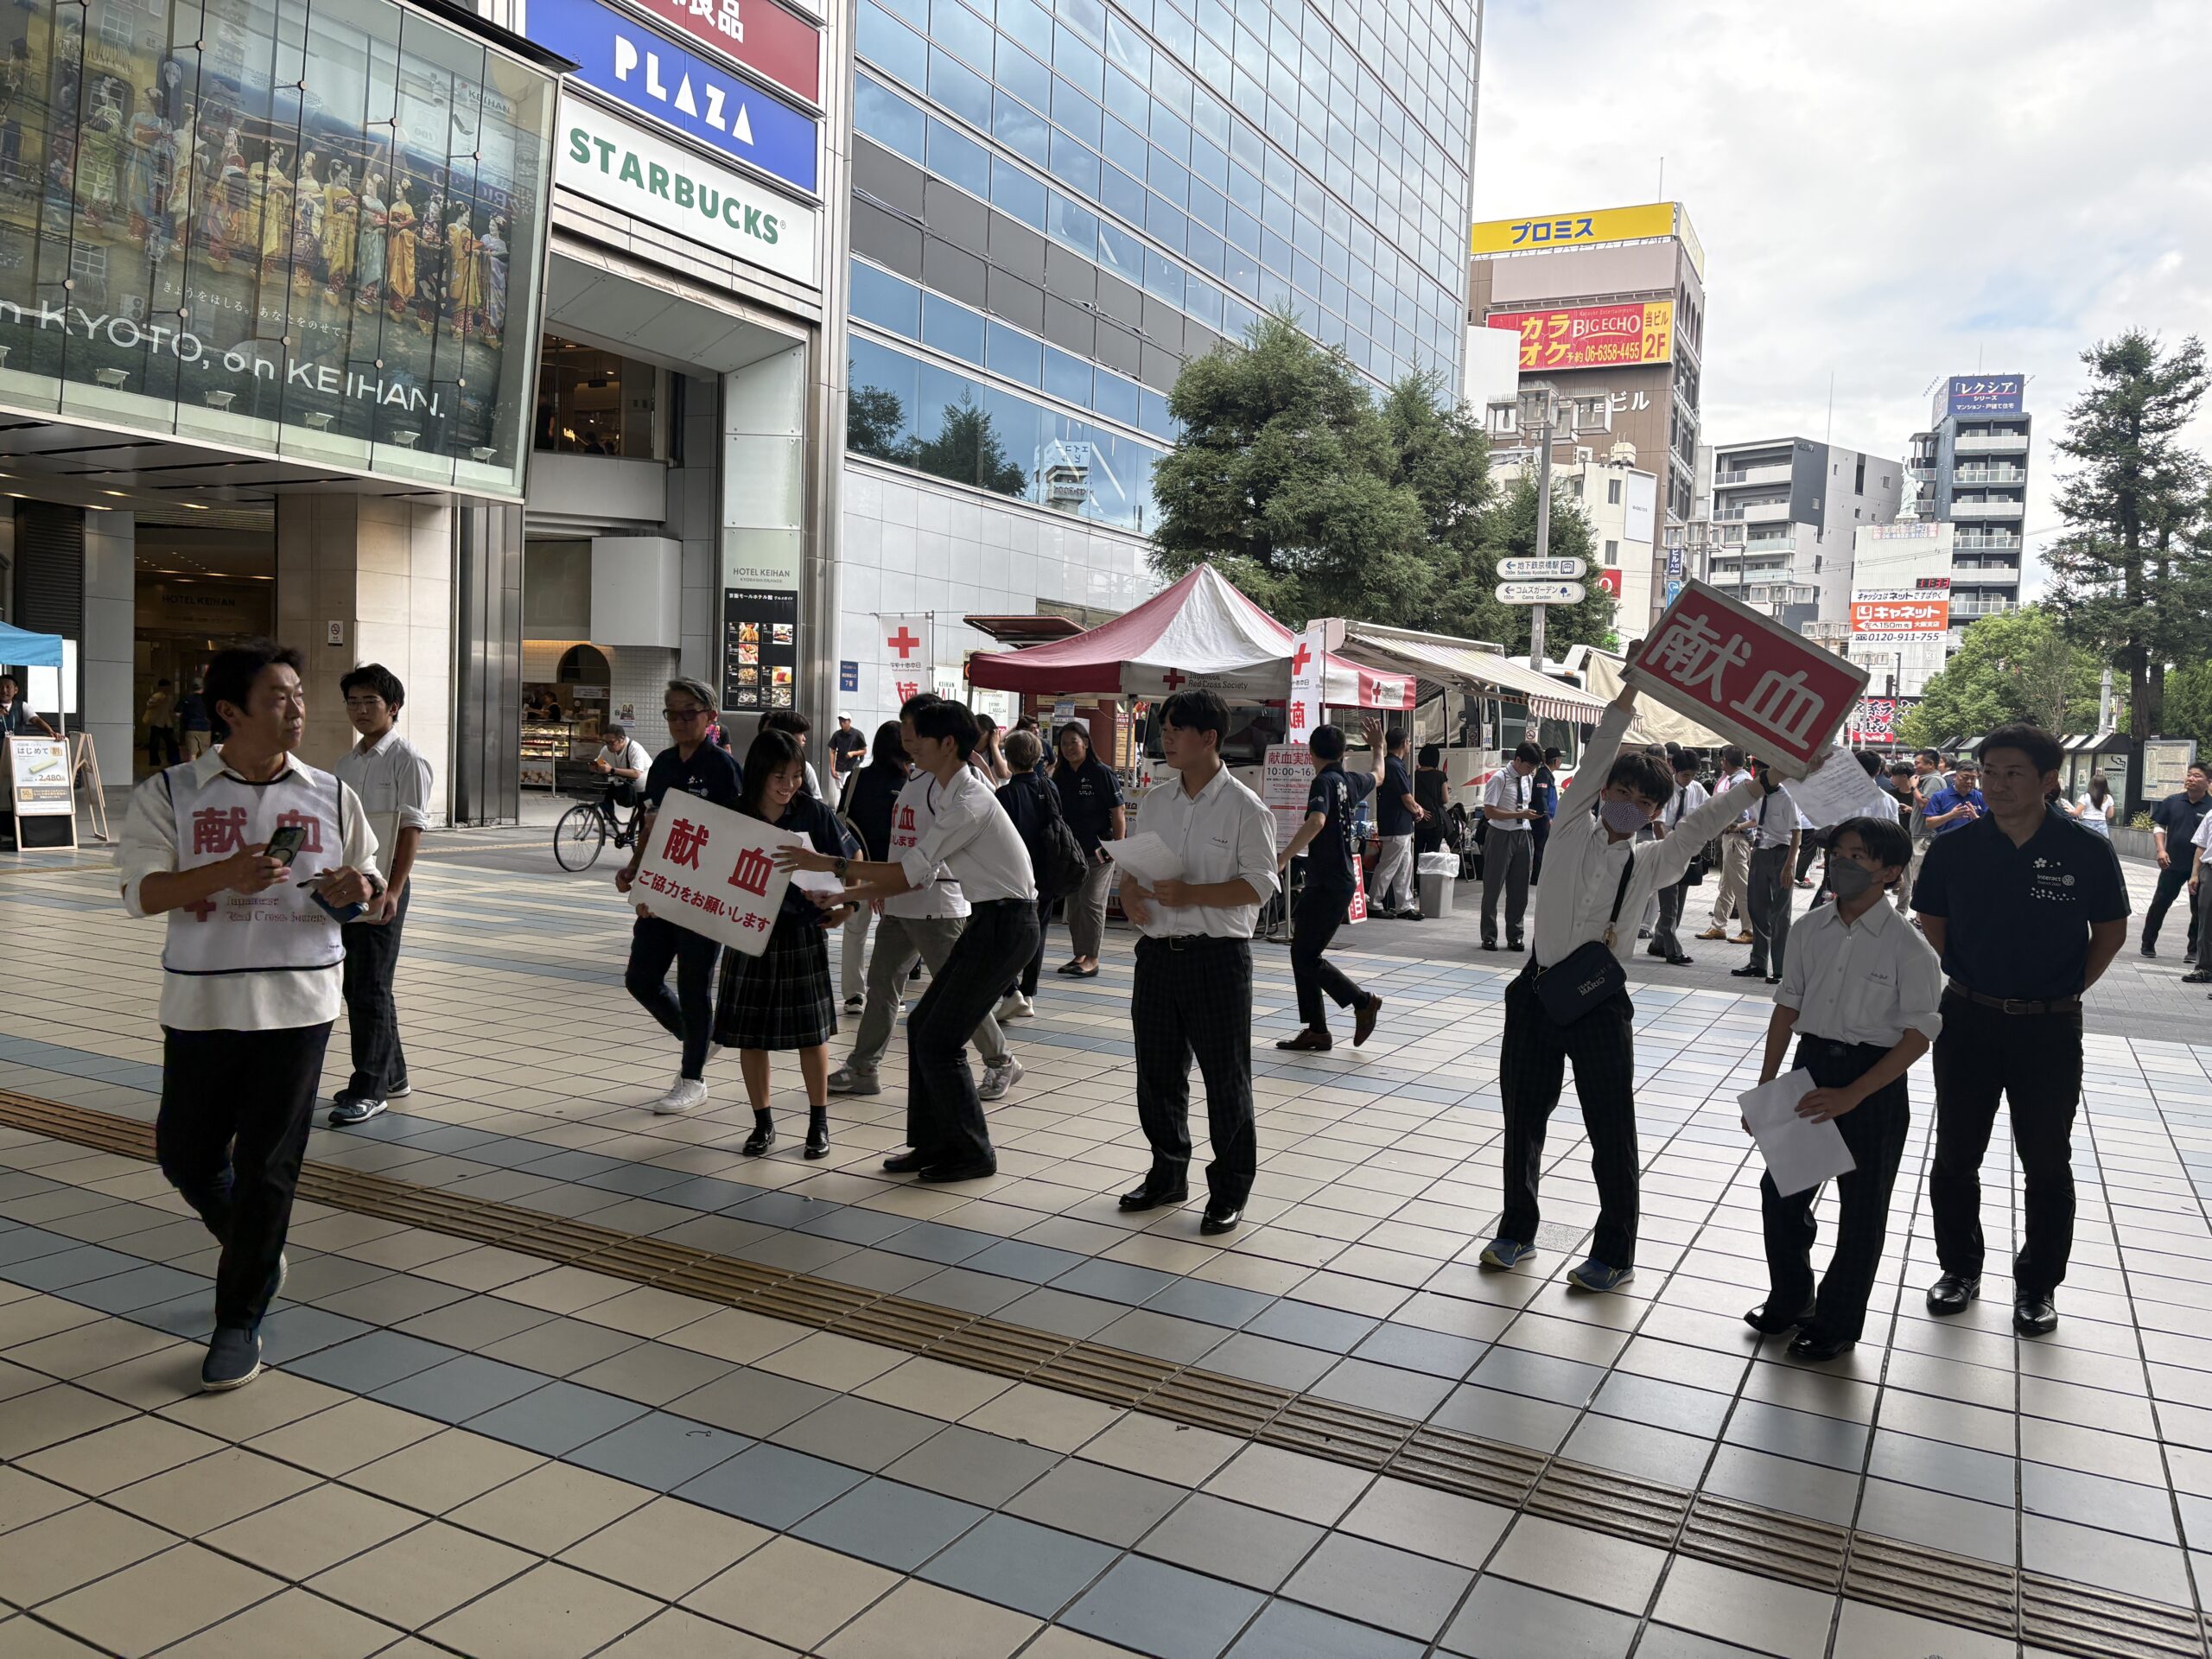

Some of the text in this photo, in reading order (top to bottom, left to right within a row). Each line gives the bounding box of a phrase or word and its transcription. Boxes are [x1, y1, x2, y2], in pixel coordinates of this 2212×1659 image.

[672, 0, 744, 43] 良品
[615, 34, 754, 146] PLAZA
[569, 128, 779, 245] STARBUCKS
[1511, 218, 1594, 245] プロミス
[1521, 314, 1571, 340] カラ
[1573, 315, 1641, 338] BIG ECHO
[1644, 310, 1669, 328] 当ビル
[41, 300, 209, 370] KYOTO,
[223, 352, 275, 379] on
[288, 358, 445, 418] KEIHAN.
[1566, 342, 1640, 364] 予約 06-6358-4455
[1643, 334, 1666, 359] 2F
[760, 569, 790, 577] KEIHAN
[1517, 561, 1559, 569] 地下鉄京橋駅
[1874, 606, 1941, 619] キャネット
[1203, 680, 1221, 689] Cross
[1223, 681, 1248, 690] Society
[1645, 613, 1824, 750] 献血
[892, 803, 916, 831] 血
[663, 817, 776, 897] 献血
[2037, 874, 2061, 882] Interact
[226, 896, 280, 907] Japanese
[638, 868, 771, 933] ご協力をお願いします
[254, 911, 288, 922] Cross
